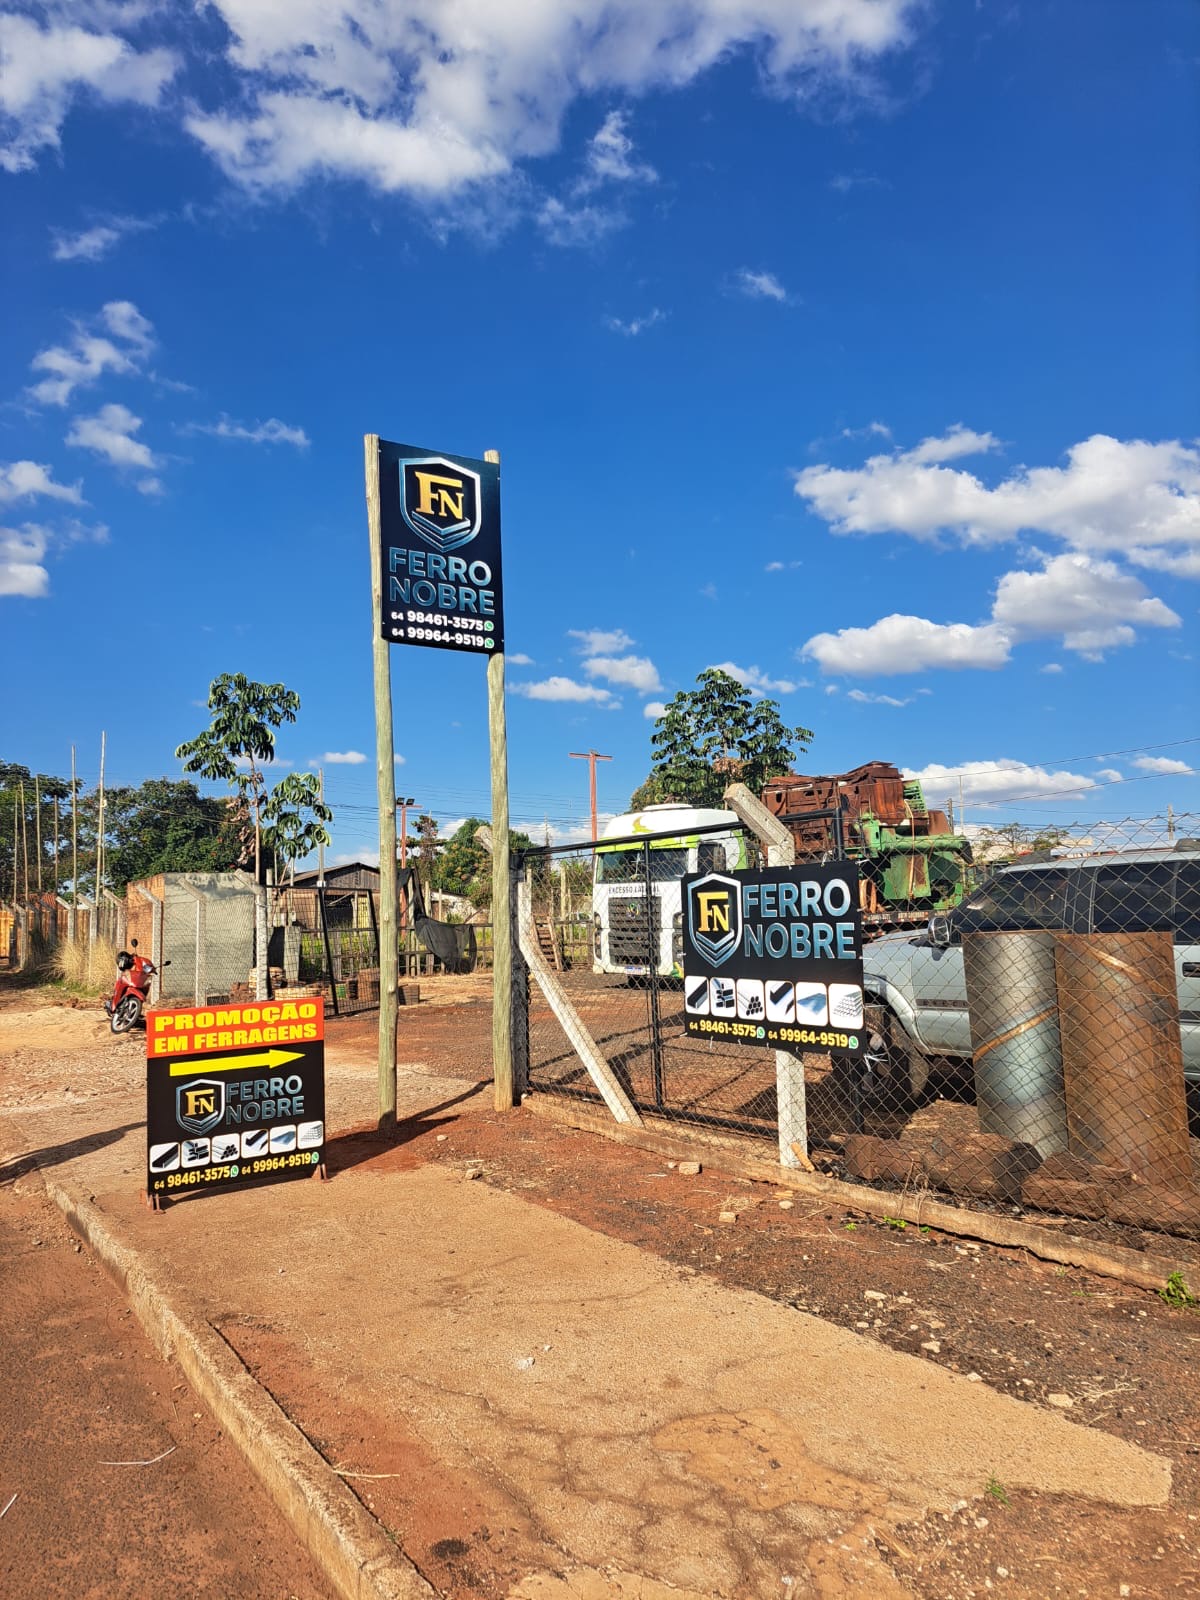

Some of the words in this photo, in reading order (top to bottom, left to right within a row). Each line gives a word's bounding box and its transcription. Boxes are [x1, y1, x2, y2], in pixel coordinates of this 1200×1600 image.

[414, 471, 464, 520] FN
[389, 546, 492, 587] FERRO
[389, 576, 495, 616] NOBRE
[391, 612, 404, 621] 64
[407, 610, 484, 632] 98461-3575
[391, 628, 404, 637] 64
[407, 626, 484, 647] 99964-9519
[608, 886, 633, 894] EXCESSO
[634, 885, 660, 893] LATAL
[742, 878, 851, 919] FERRO
[697, 891, 730, 932] FN
[743, 922, 857, 960] NOBRE
[154, 1002, 317, 1032] PROMOÇÃO
[154, 1035, 189, 1054] EM
[194, 1023, 317, 1050] FERRAGENS
[689, 1022, 698, 1031] 64
[699, 1019, 757, 1038] 98461-3575
[768, 1030, 778, 1040] 64
[779, 1028, 848, 1047] 99964-9519
[185, 1088, 215, 1117] FN
[226, 1074, 303, 1103] FERRO
[226, 1095, 305, 1126] NOBRE
[154, 1180, 165, 1190] 64
[167, 1166, 231, 1188] 98461-3575
[241, 1166, 251, 1176] 64
[253, 1152, 311, 1173] 99964-9519
